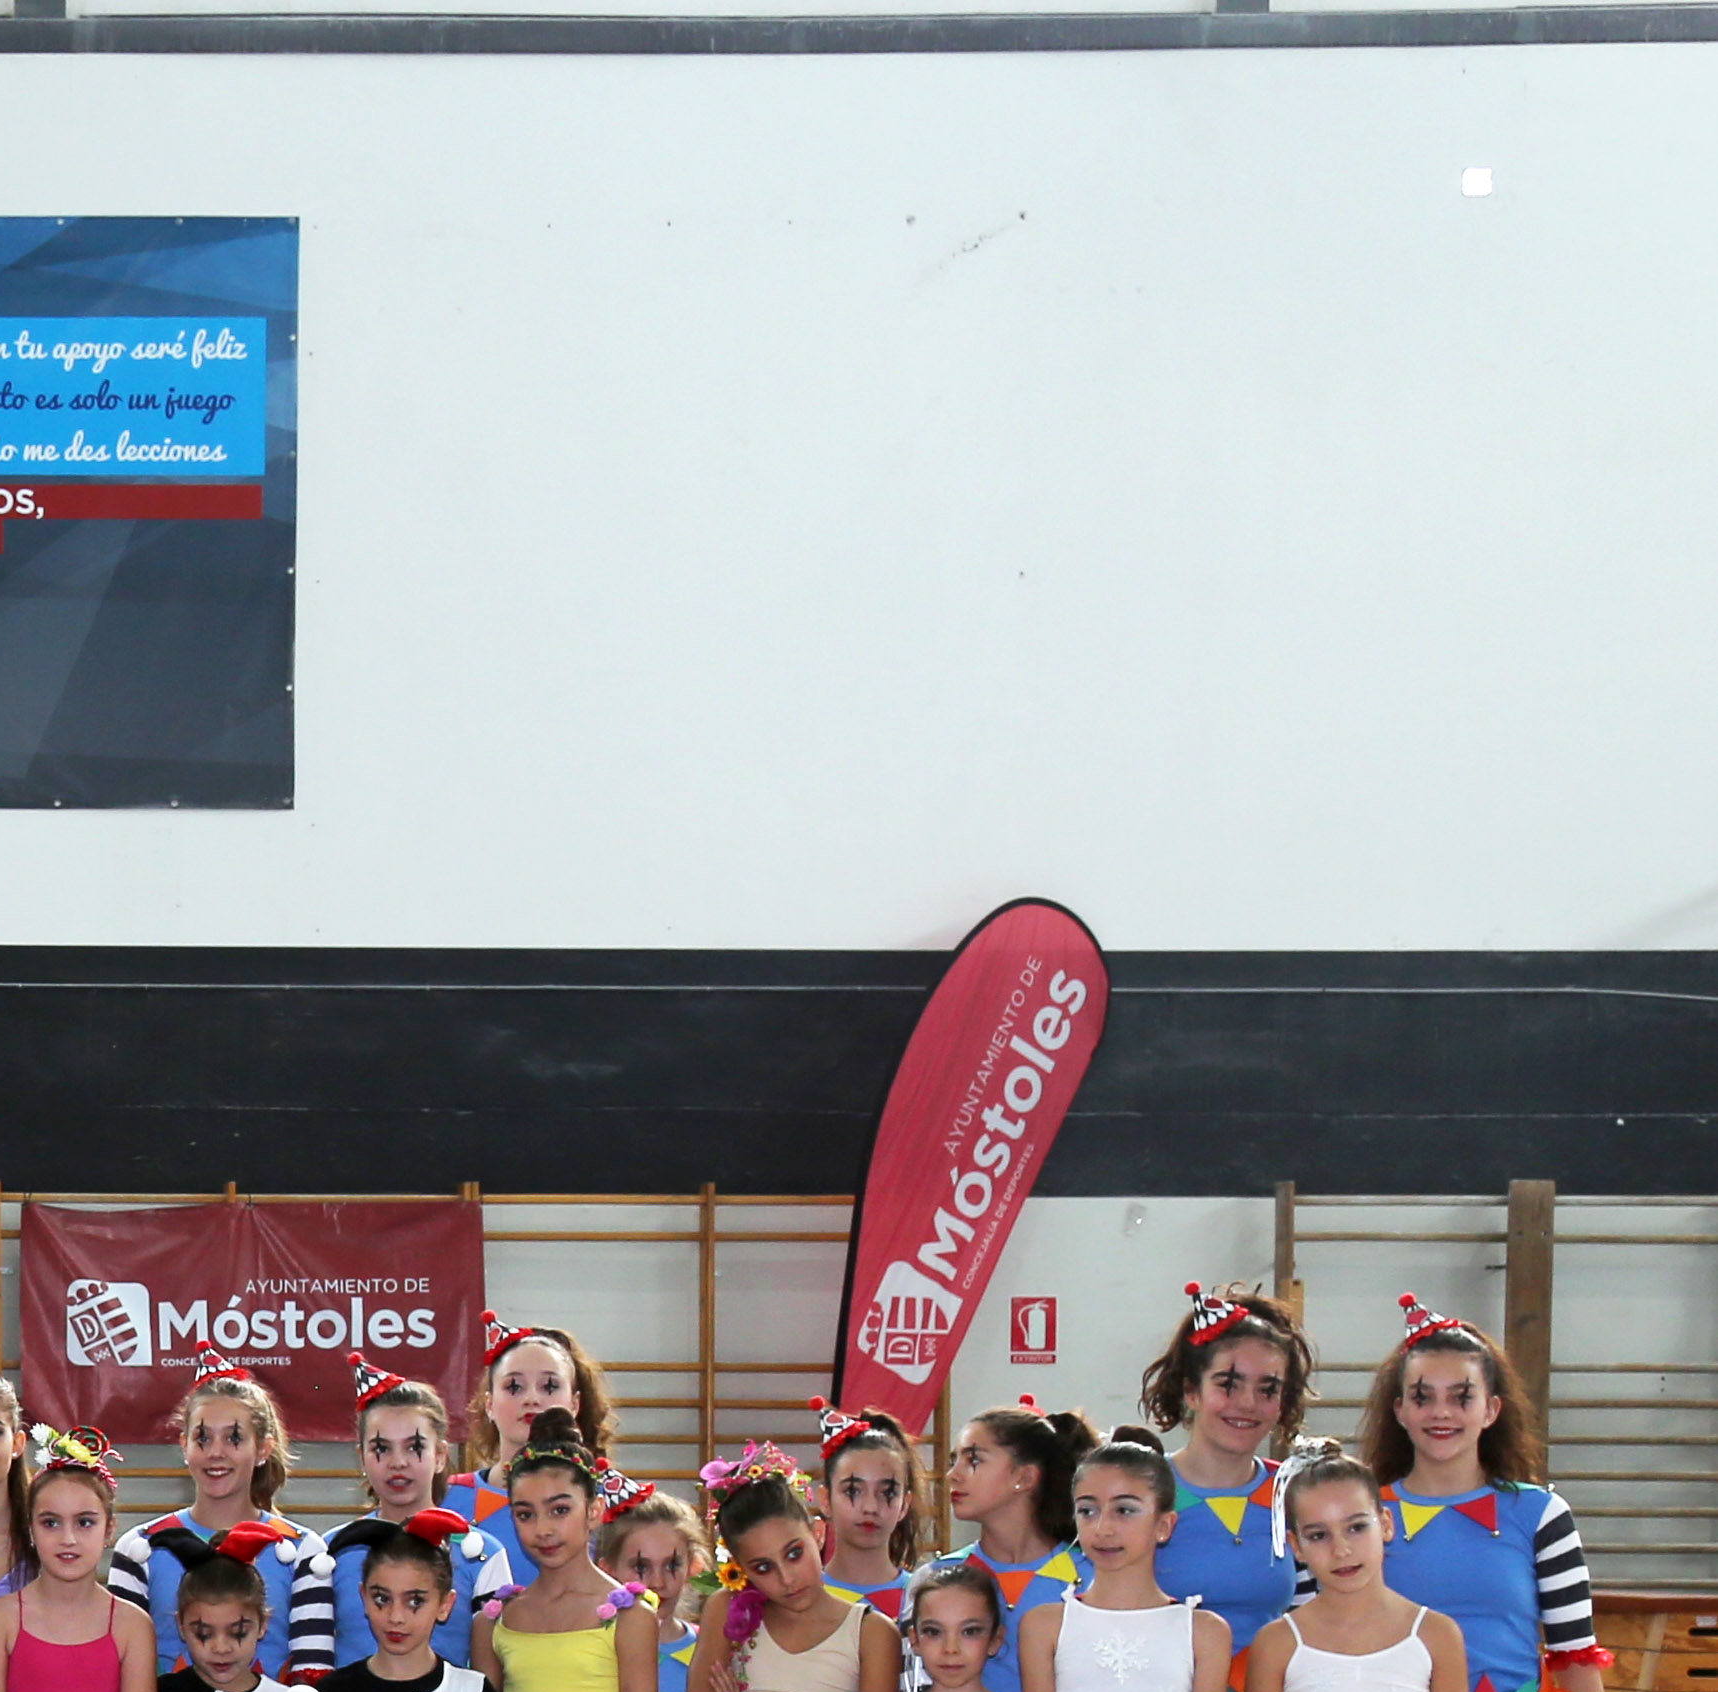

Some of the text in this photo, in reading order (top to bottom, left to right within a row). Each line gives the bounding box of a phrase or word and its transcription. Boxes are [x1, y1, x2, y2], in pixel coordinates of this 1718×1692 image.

[13, 330, 48, 361] tu
[52, 341, 127, 374] apoyo
[130, 330, 188, 361] seré
[190, 328, 248, 369] feliz
[34, 392, 64, 410] es
[68, 379, 123, 410] solo
[128, 392, 161, 410] un
[164, 387, 237, 425] juego
[22, 443, 60, 462] me
[64, 429, 112, 462] des
[115, 429, 228, 462] lecciones
[943, 954, 1043, 1156] AYUNTAMIENTO DE
[916, 969, 1087, 1282] Móstoles
[995, 1201, 1008, 1219] DE
[1004, 1143, 1035, 1200] DEPORTES
[245, 1278, 430, 1295] AYUNTAMIENTO DE
[157, 1294, 438, 1351] Móstoles
